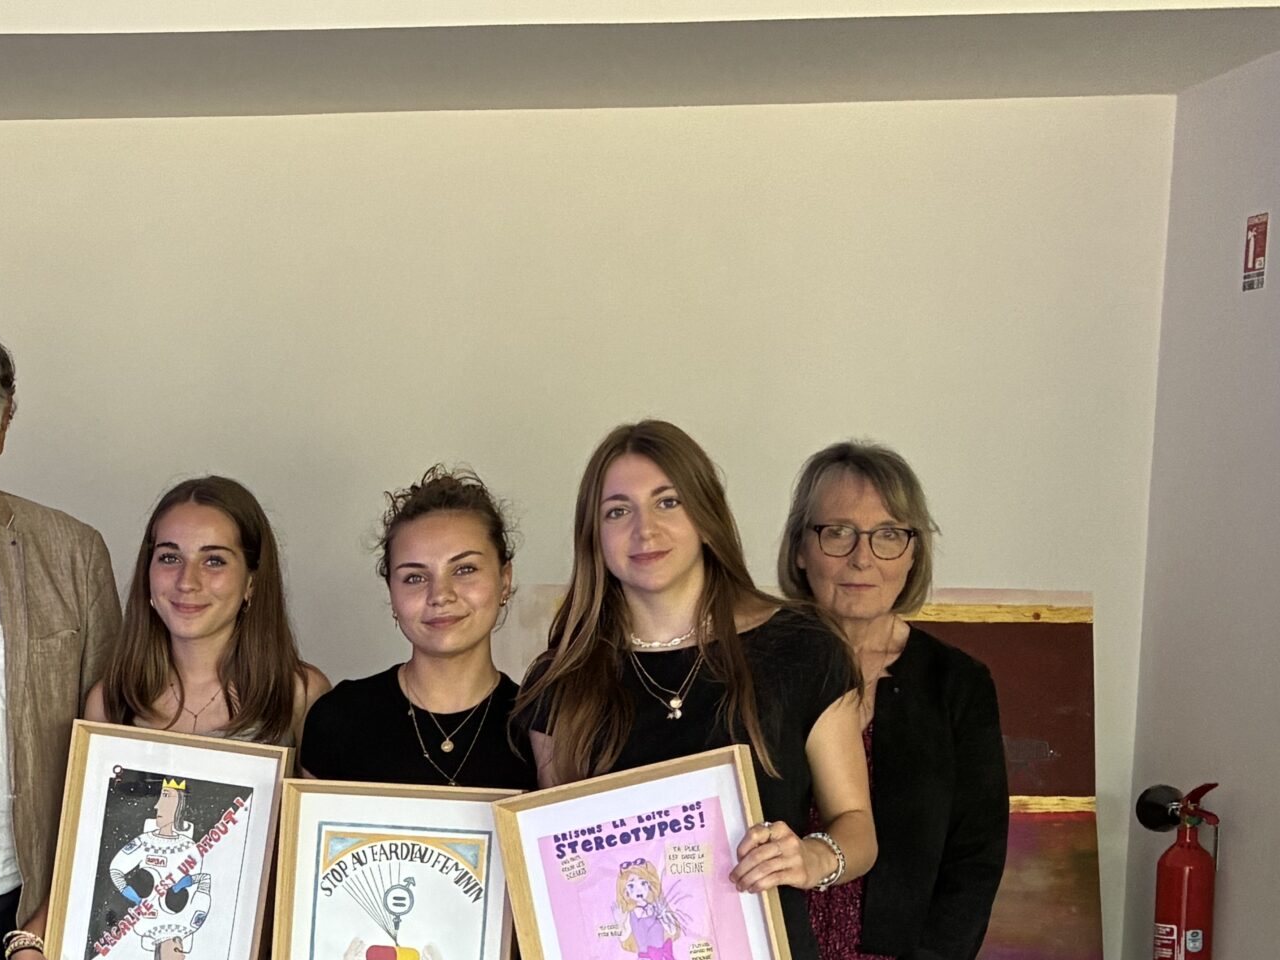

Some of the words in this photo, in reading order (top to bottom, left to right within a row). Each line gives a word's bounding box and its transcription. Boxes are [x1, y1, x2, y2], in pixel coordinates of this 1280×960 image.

[612, 818, 626, 829] LA
[155, 872, 176, 897] EST
[177, 855, 197, 876] UN
[196, 809, 238, 858] ATOUT
[320, 860, 348, 897] STOP
[351, 850, 368, 871] AU
[431, 854, 484, 903] FEMININ
